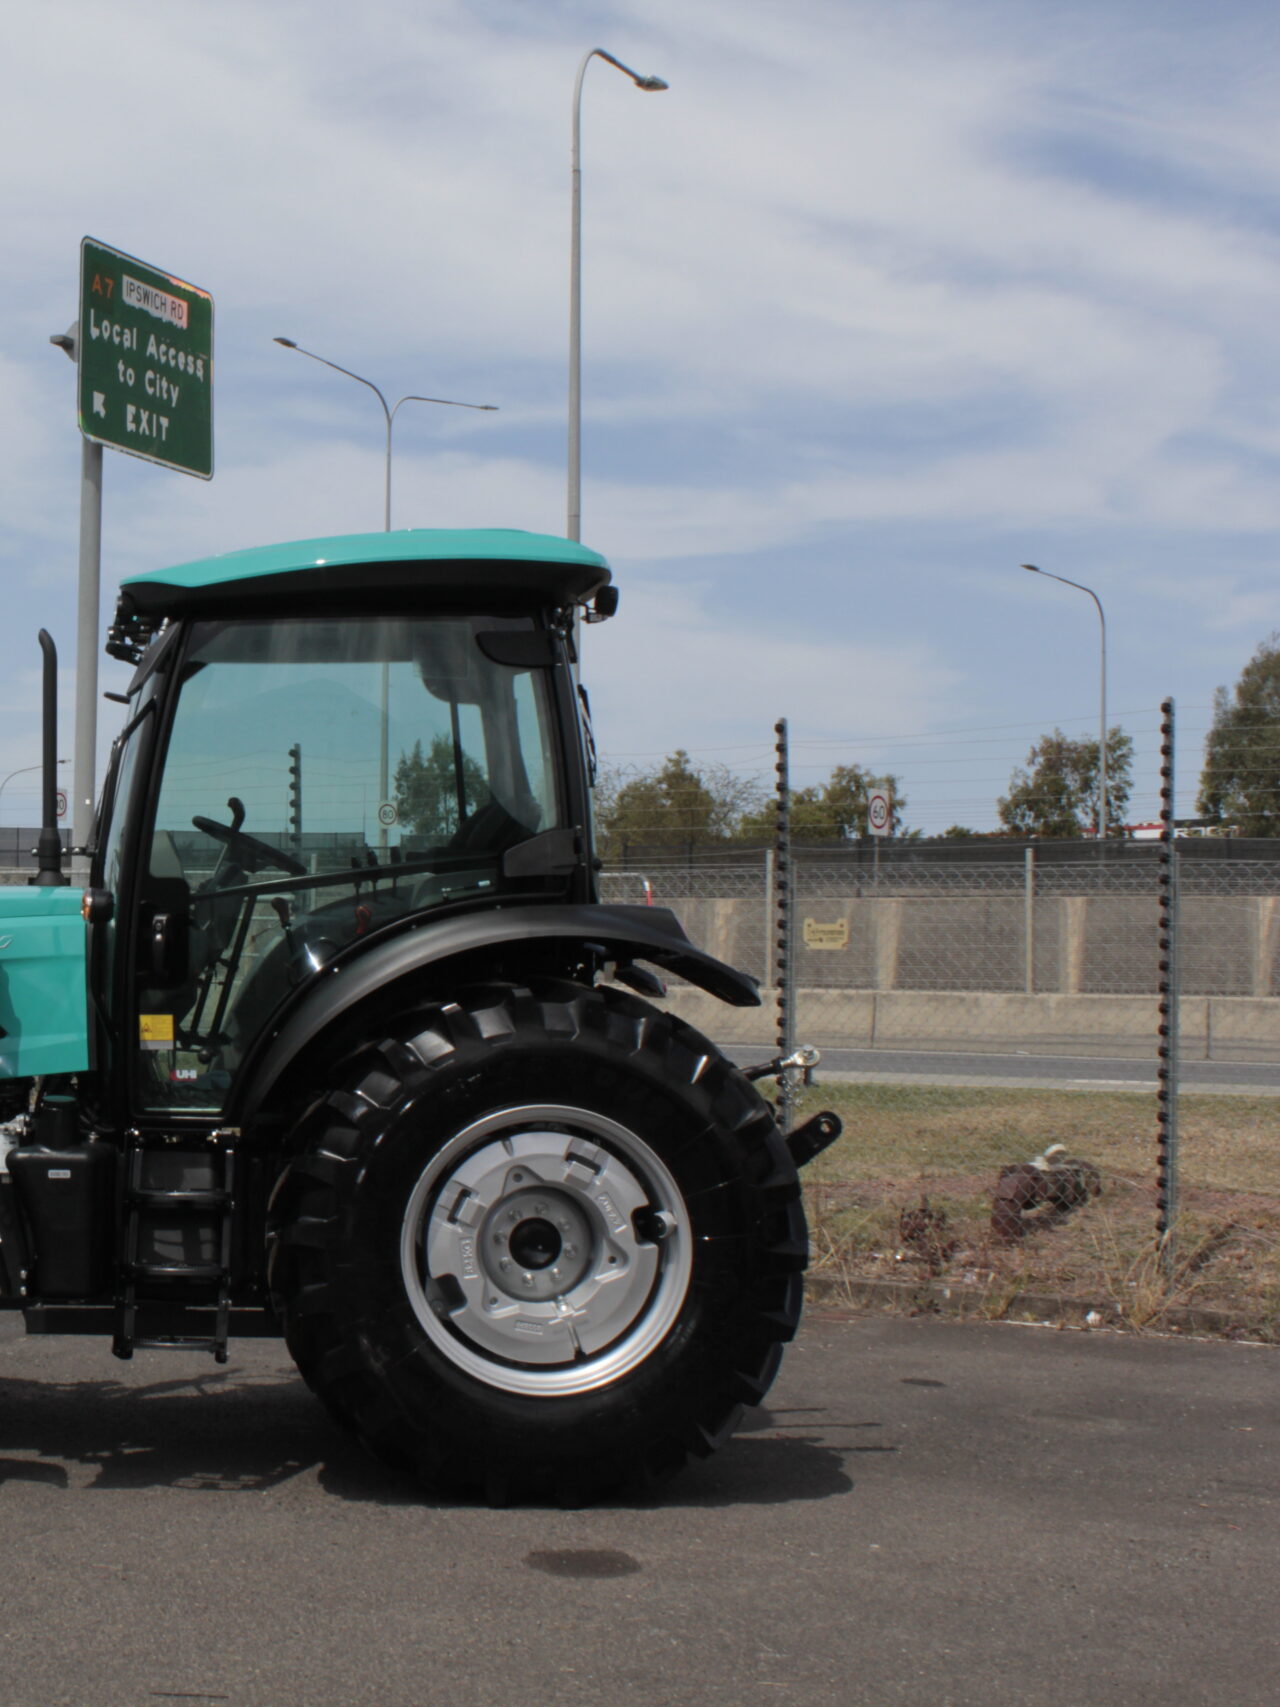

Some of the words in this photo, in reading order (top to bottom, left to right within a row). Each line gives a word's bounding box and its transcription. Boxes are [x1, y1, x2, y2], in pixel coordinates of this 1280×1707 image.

[92, 273, 114, 298] A7
[126, 280, 167, 313] IPSWICH
[170, 301, 184, 320] RD
[90, 308, 137, 350] Local
[146, 334, 204, 381] Access
[118, 359, 135, 387] to
[145, 372, 180, 407] City
[126, 404, 169, 440] EXIT
[873, 804, 885, 819] 60
[176, 1069, 197, 1079] UHI
